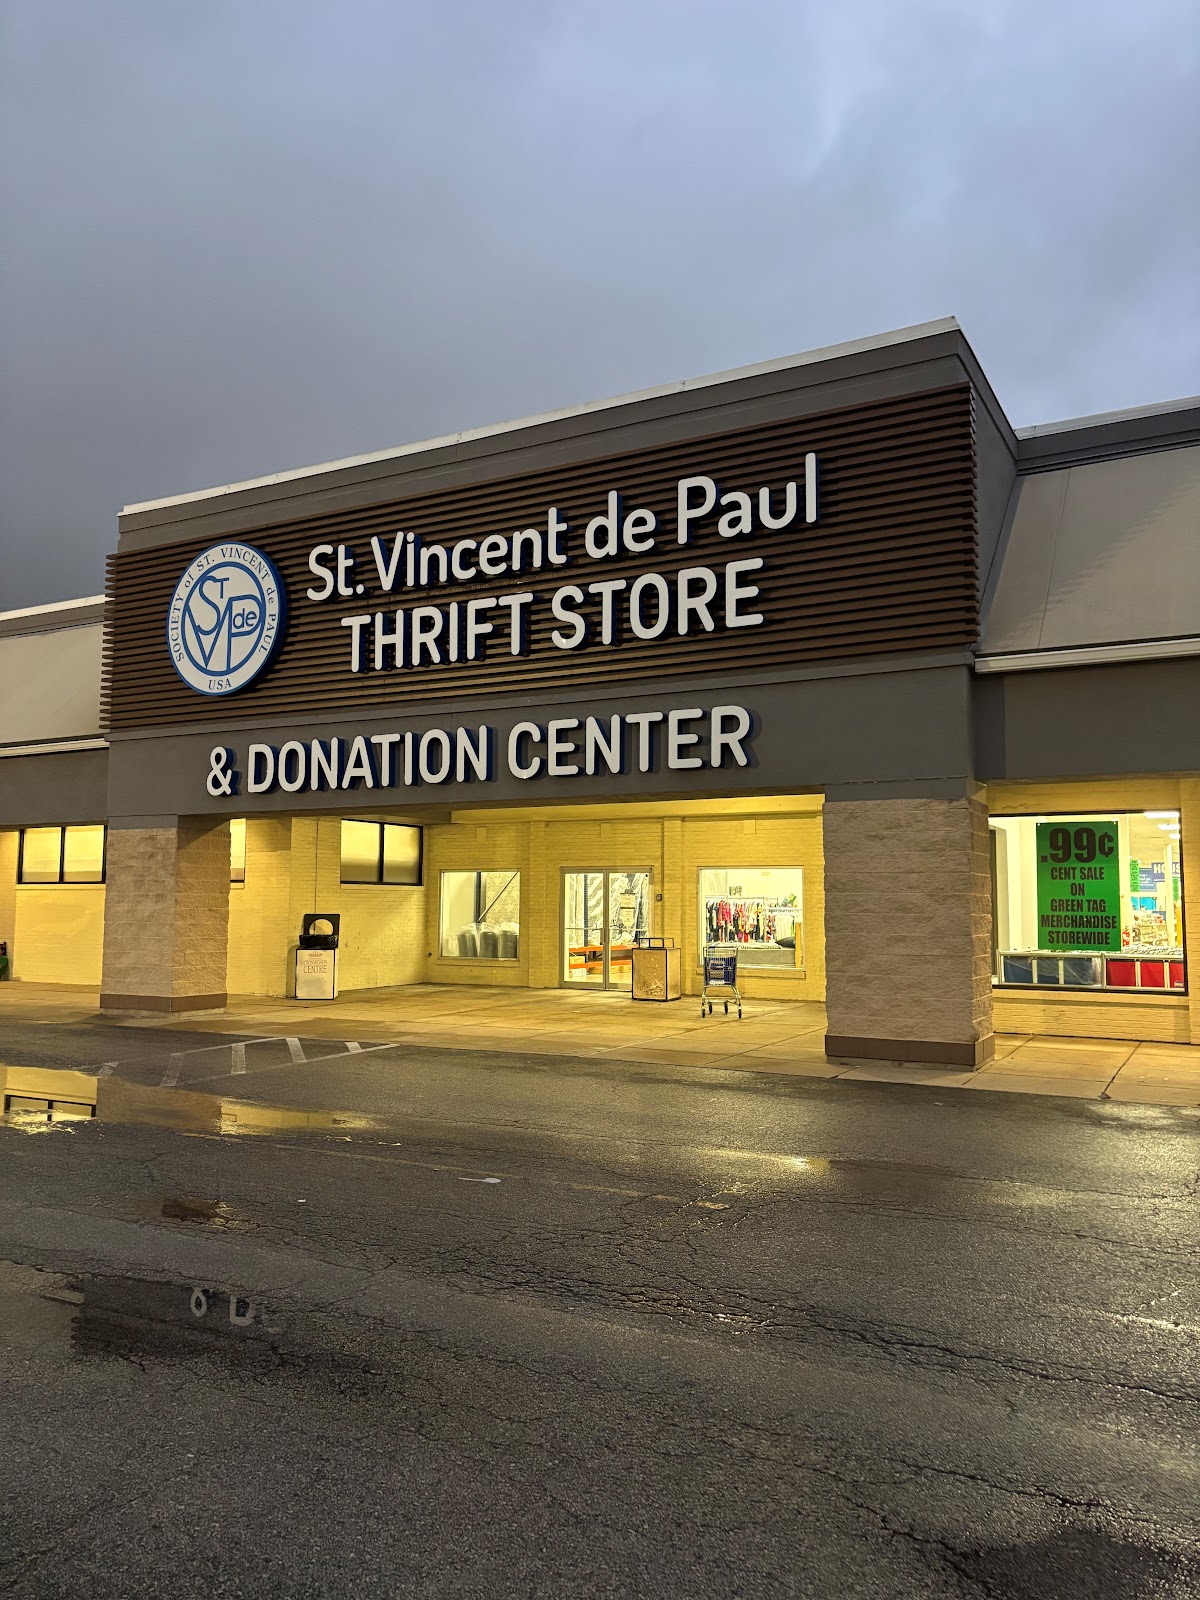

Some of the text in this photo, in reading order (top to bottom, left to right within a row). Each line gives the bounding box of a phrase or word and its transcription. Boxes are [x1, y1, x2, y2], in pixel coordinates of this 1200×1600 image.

[307, 452, 817, 601] St. Vincent de Paul
[171, 547, 277, 662] SOCIETY of ST. VINCENT de PAUL
[341, 557, 764, 673] THRIFT STORE
[208, 678, 232, 691] USA
[206, 705, 750, 797] & DONATION CENTER
[1040, 827, 1115, 864] .99¢
[1050, 866, 1105, 881] CENT SALE
[1070, 882, 1085, 896] ON
[1050, 898, 1107, 913] GREEN TAG
[1040, 914, 1118, 929] MERCHANDISE
[1047, 930, 1111, 945] STOREWIDE
[303, 964, 328, 974] CENTRE
